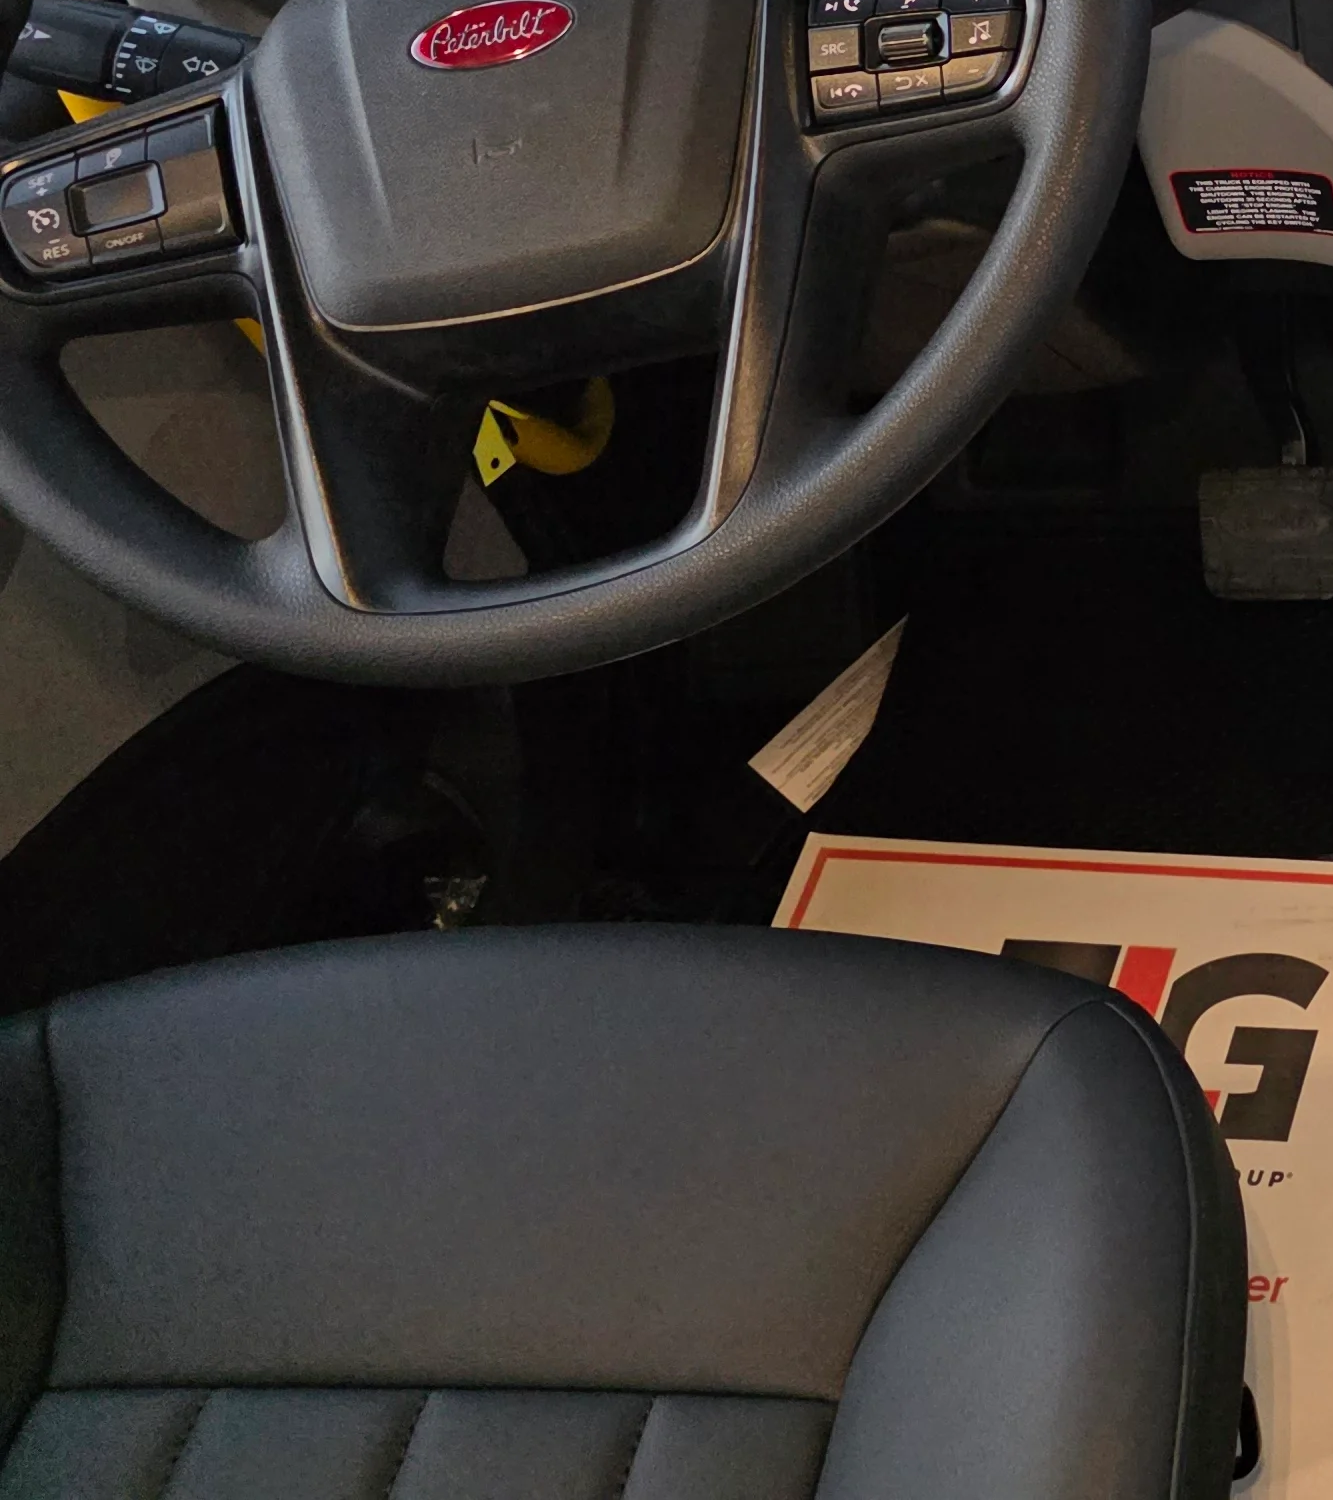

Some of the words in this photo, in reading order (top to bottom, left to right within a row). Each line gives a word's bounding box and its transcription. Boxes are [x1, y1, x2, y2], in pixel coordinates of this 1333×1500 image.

[430, 6, 556, 61] Peterbilt
[820, 42, 847, 56] SRC
[27, 172, 54, 189] SET
[105, 232, 145, 249] ON/OFF
[42, 243, 71, 261] RES
